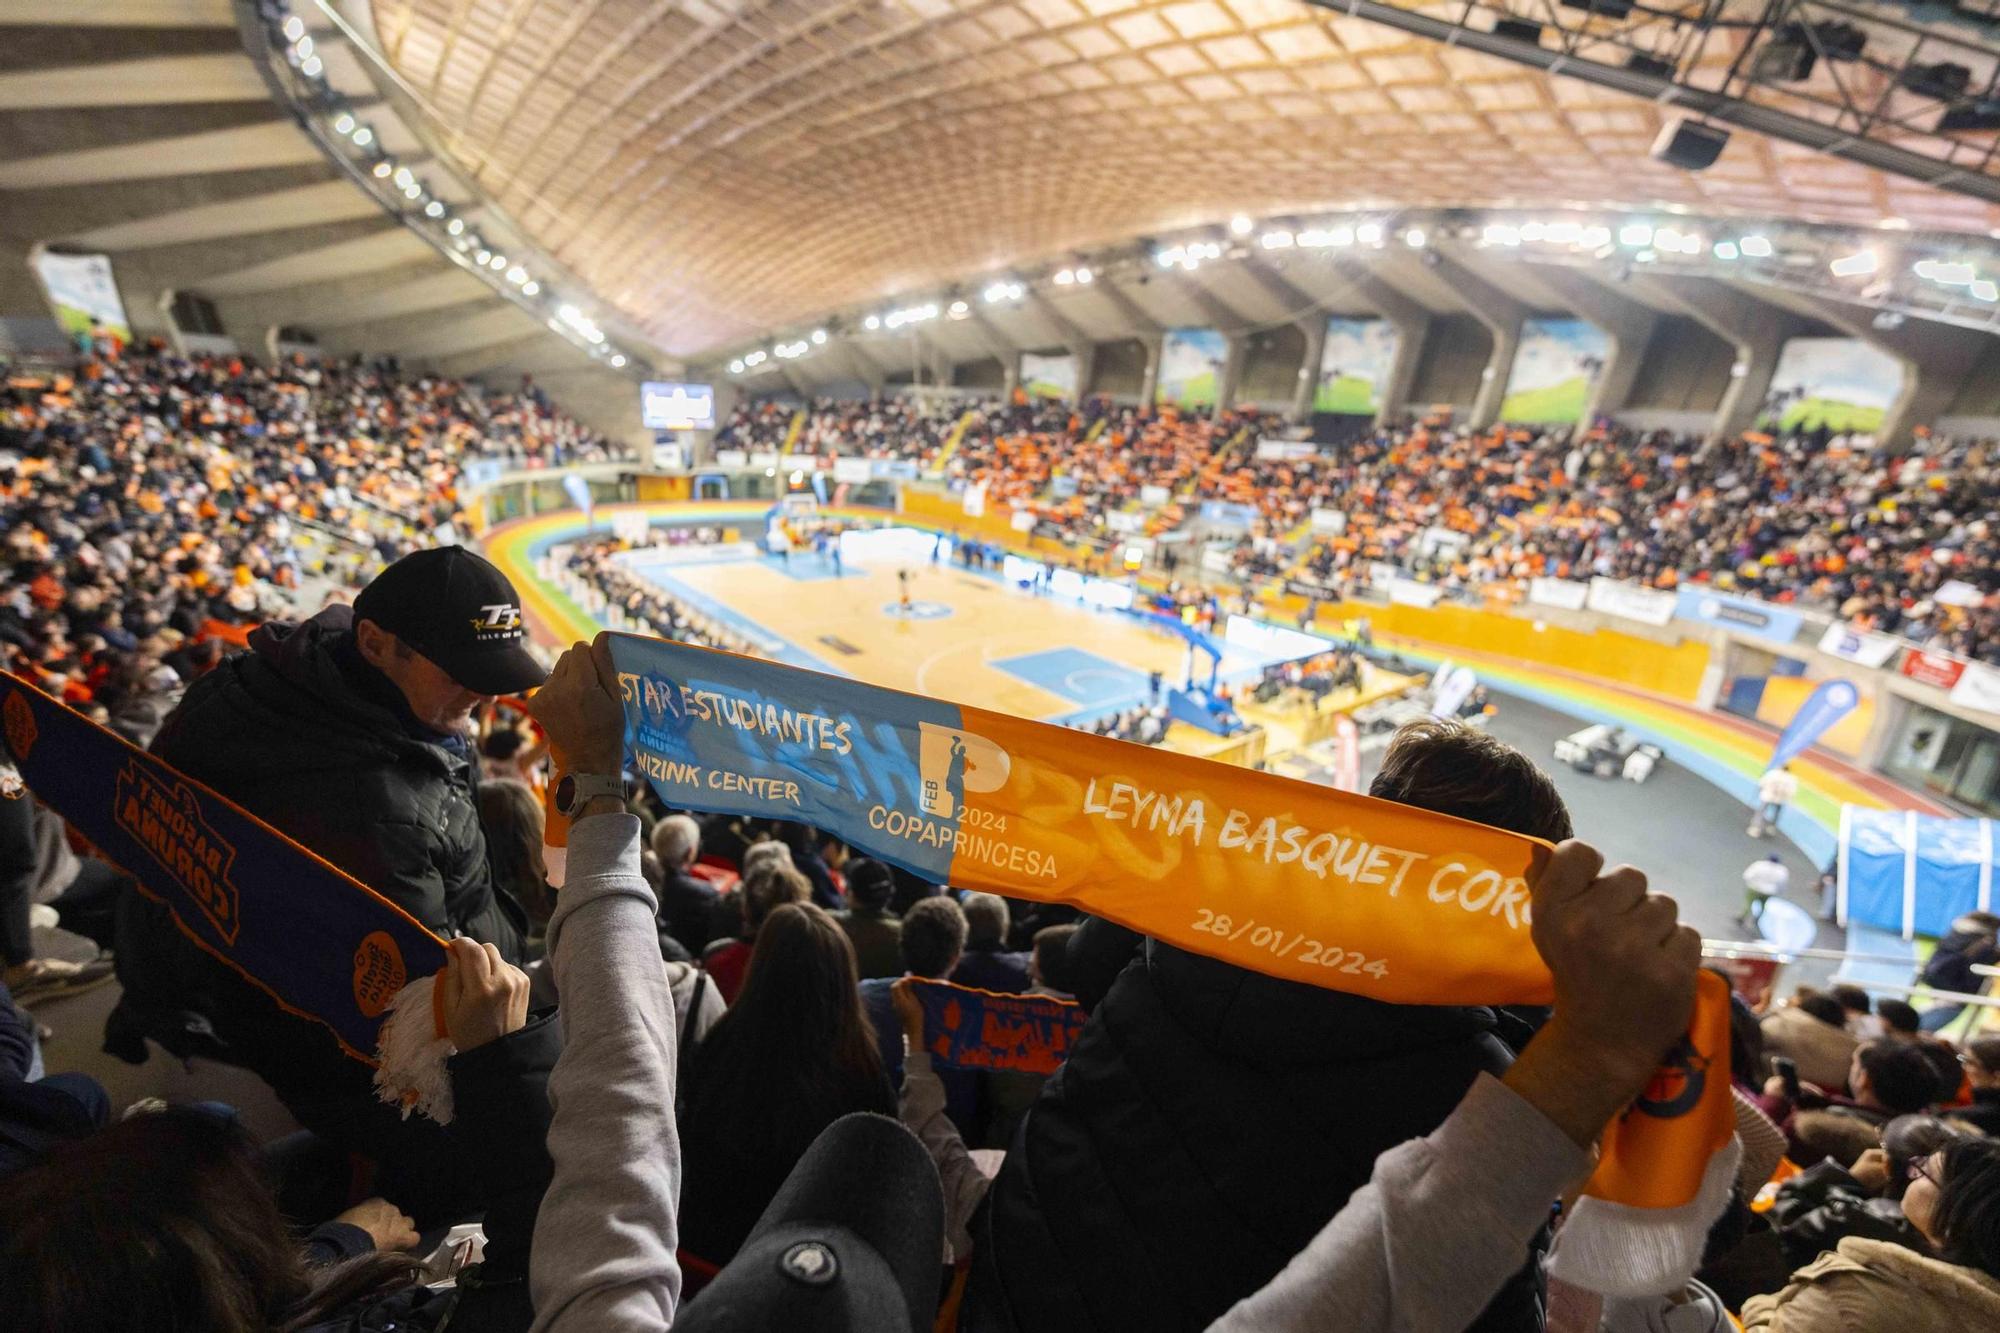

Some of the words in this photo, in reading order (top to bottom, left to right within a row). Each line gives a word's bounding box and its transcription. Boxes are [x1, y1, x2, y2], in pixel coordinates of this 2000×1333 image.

[480, 603, 520, 630] TT
[679, 685, 853, 756] ESTUDIANTES
[635, 748, 700, 788] WIZINK
[707, 768, 801, 806] CENTER
[923, 778, 939, 811] FEB
[955, 804, 1008, 835] 2024
[1082, 775, 1207, 847] LEYMA
[1218, 808, 1430, 897] BASQUET
[1427, 862, 1533, 929] COR
[1191, 907, 1390, 980] 28/01/2024
